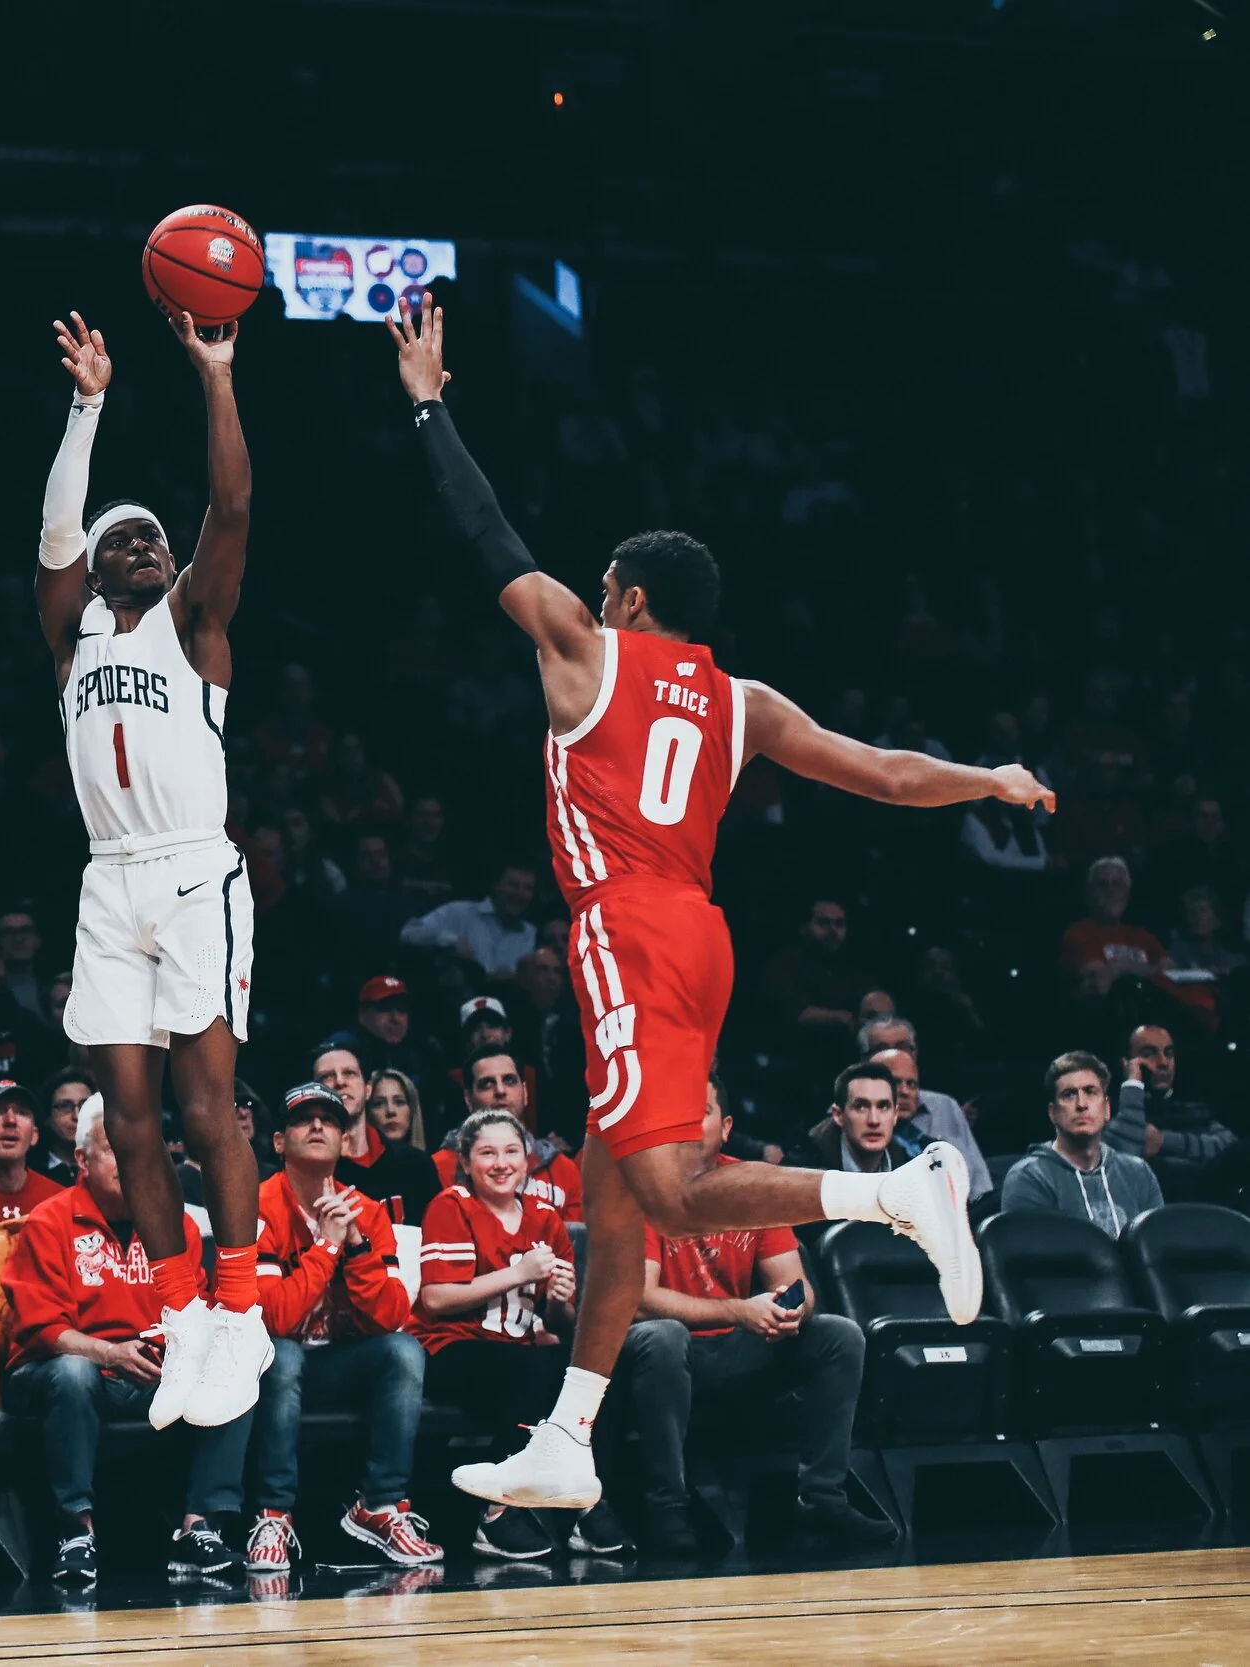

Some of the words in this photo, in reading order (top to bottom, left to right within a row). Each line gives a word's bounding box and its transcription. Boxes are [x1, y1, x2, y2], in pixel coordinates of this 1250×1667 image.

[76, 664, 169, 721] SPIDERS
[654, 679, 709, 717] TRICE
[113, 723, 131, 789] 1
[638, 716, 703, 826] 0
